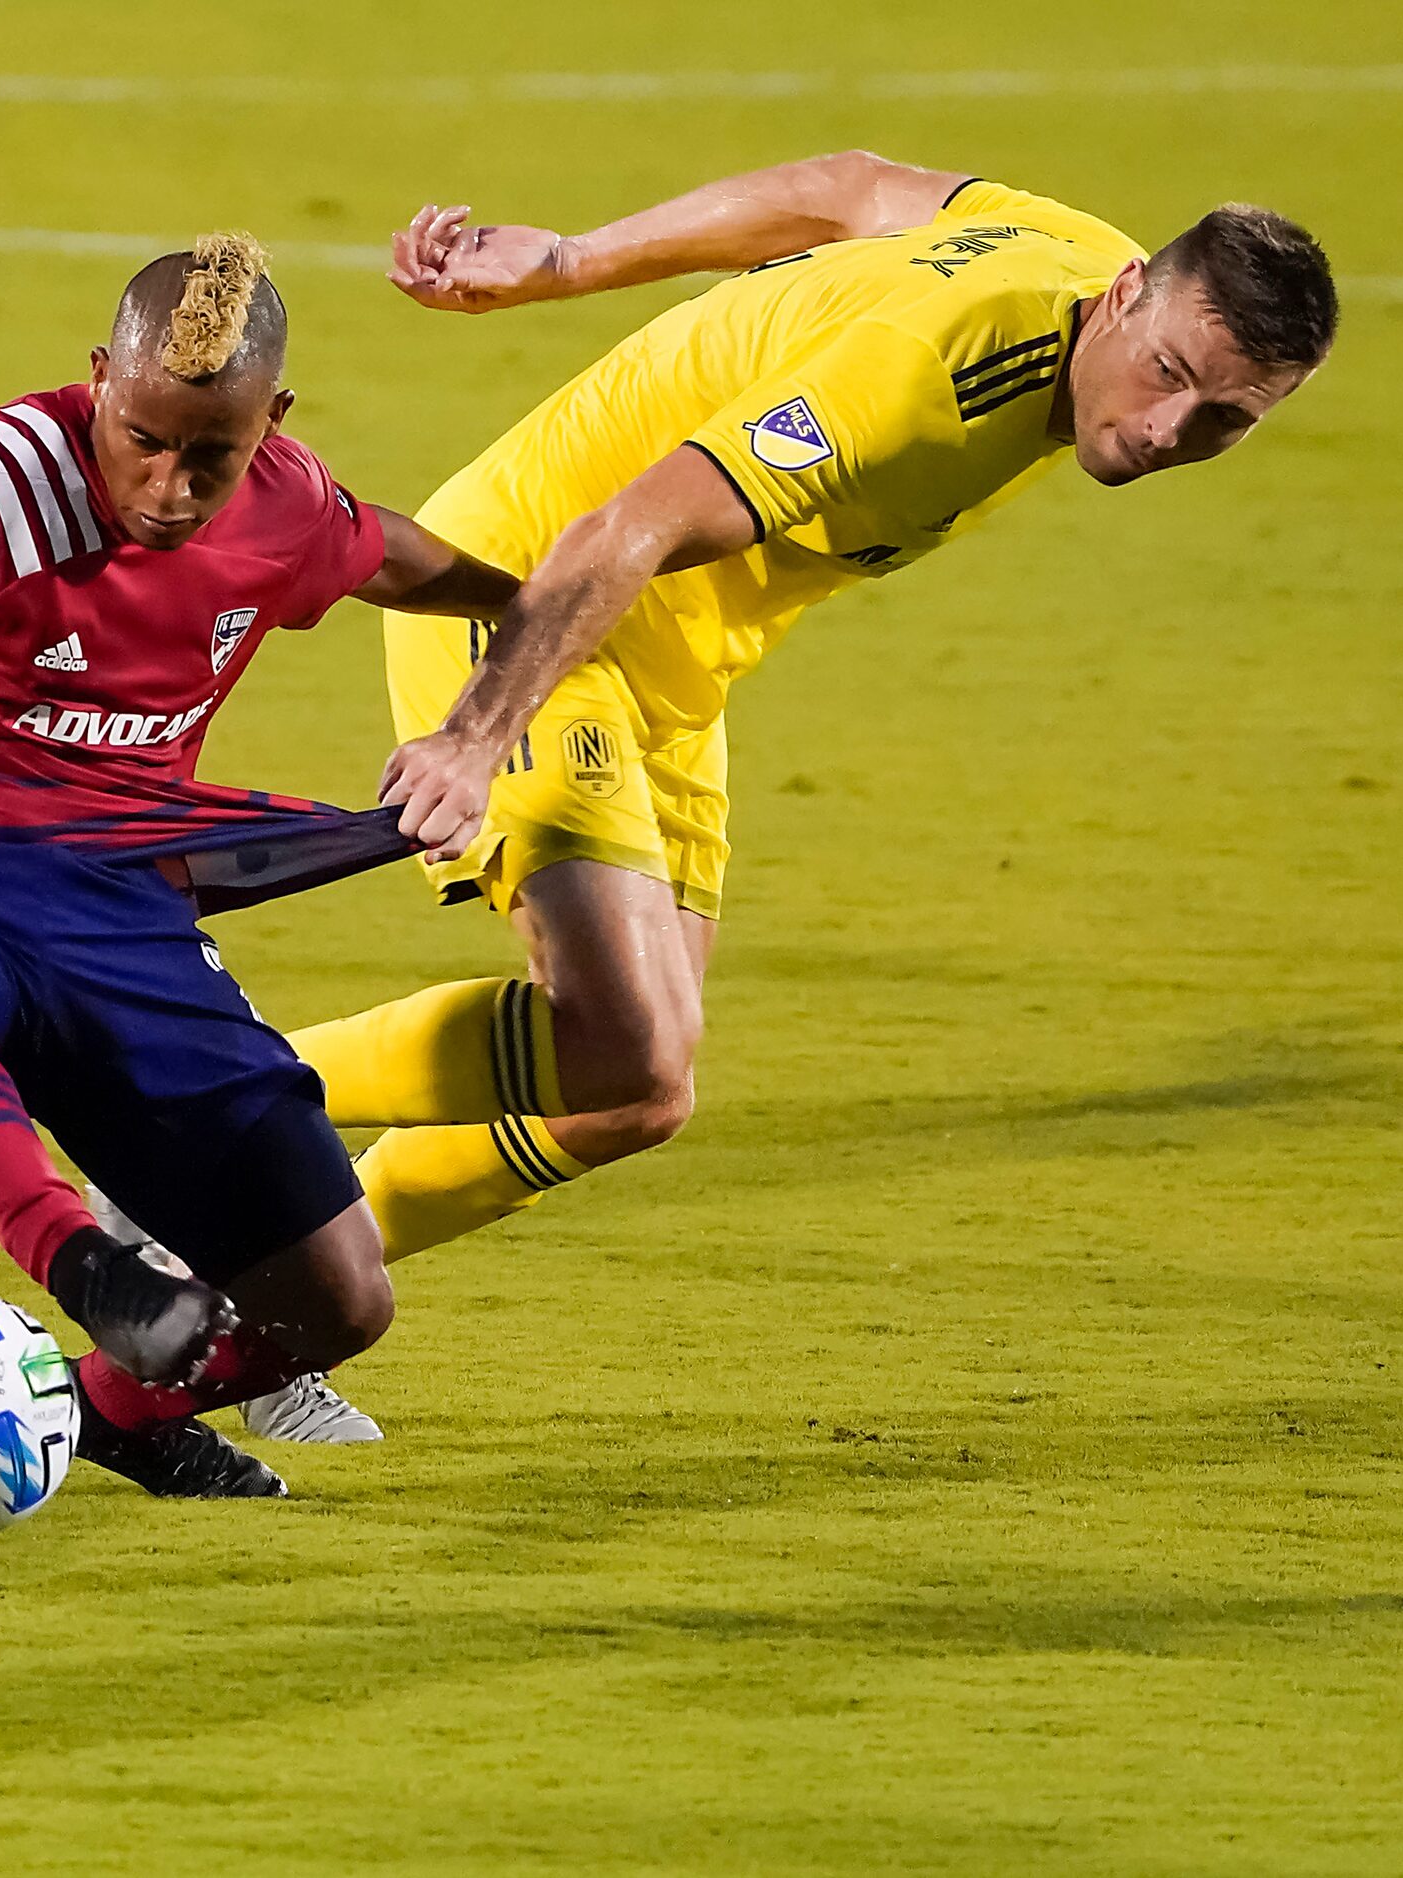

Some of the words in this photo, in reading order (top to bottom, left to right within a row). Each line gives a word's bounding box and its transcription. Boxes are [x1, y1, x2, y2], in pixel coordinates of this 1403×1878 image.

[786, 405, 813, 437] MLS
[34, 655, 88, 671] adidas
[12, 704, 214, 746] ADVOCARE
